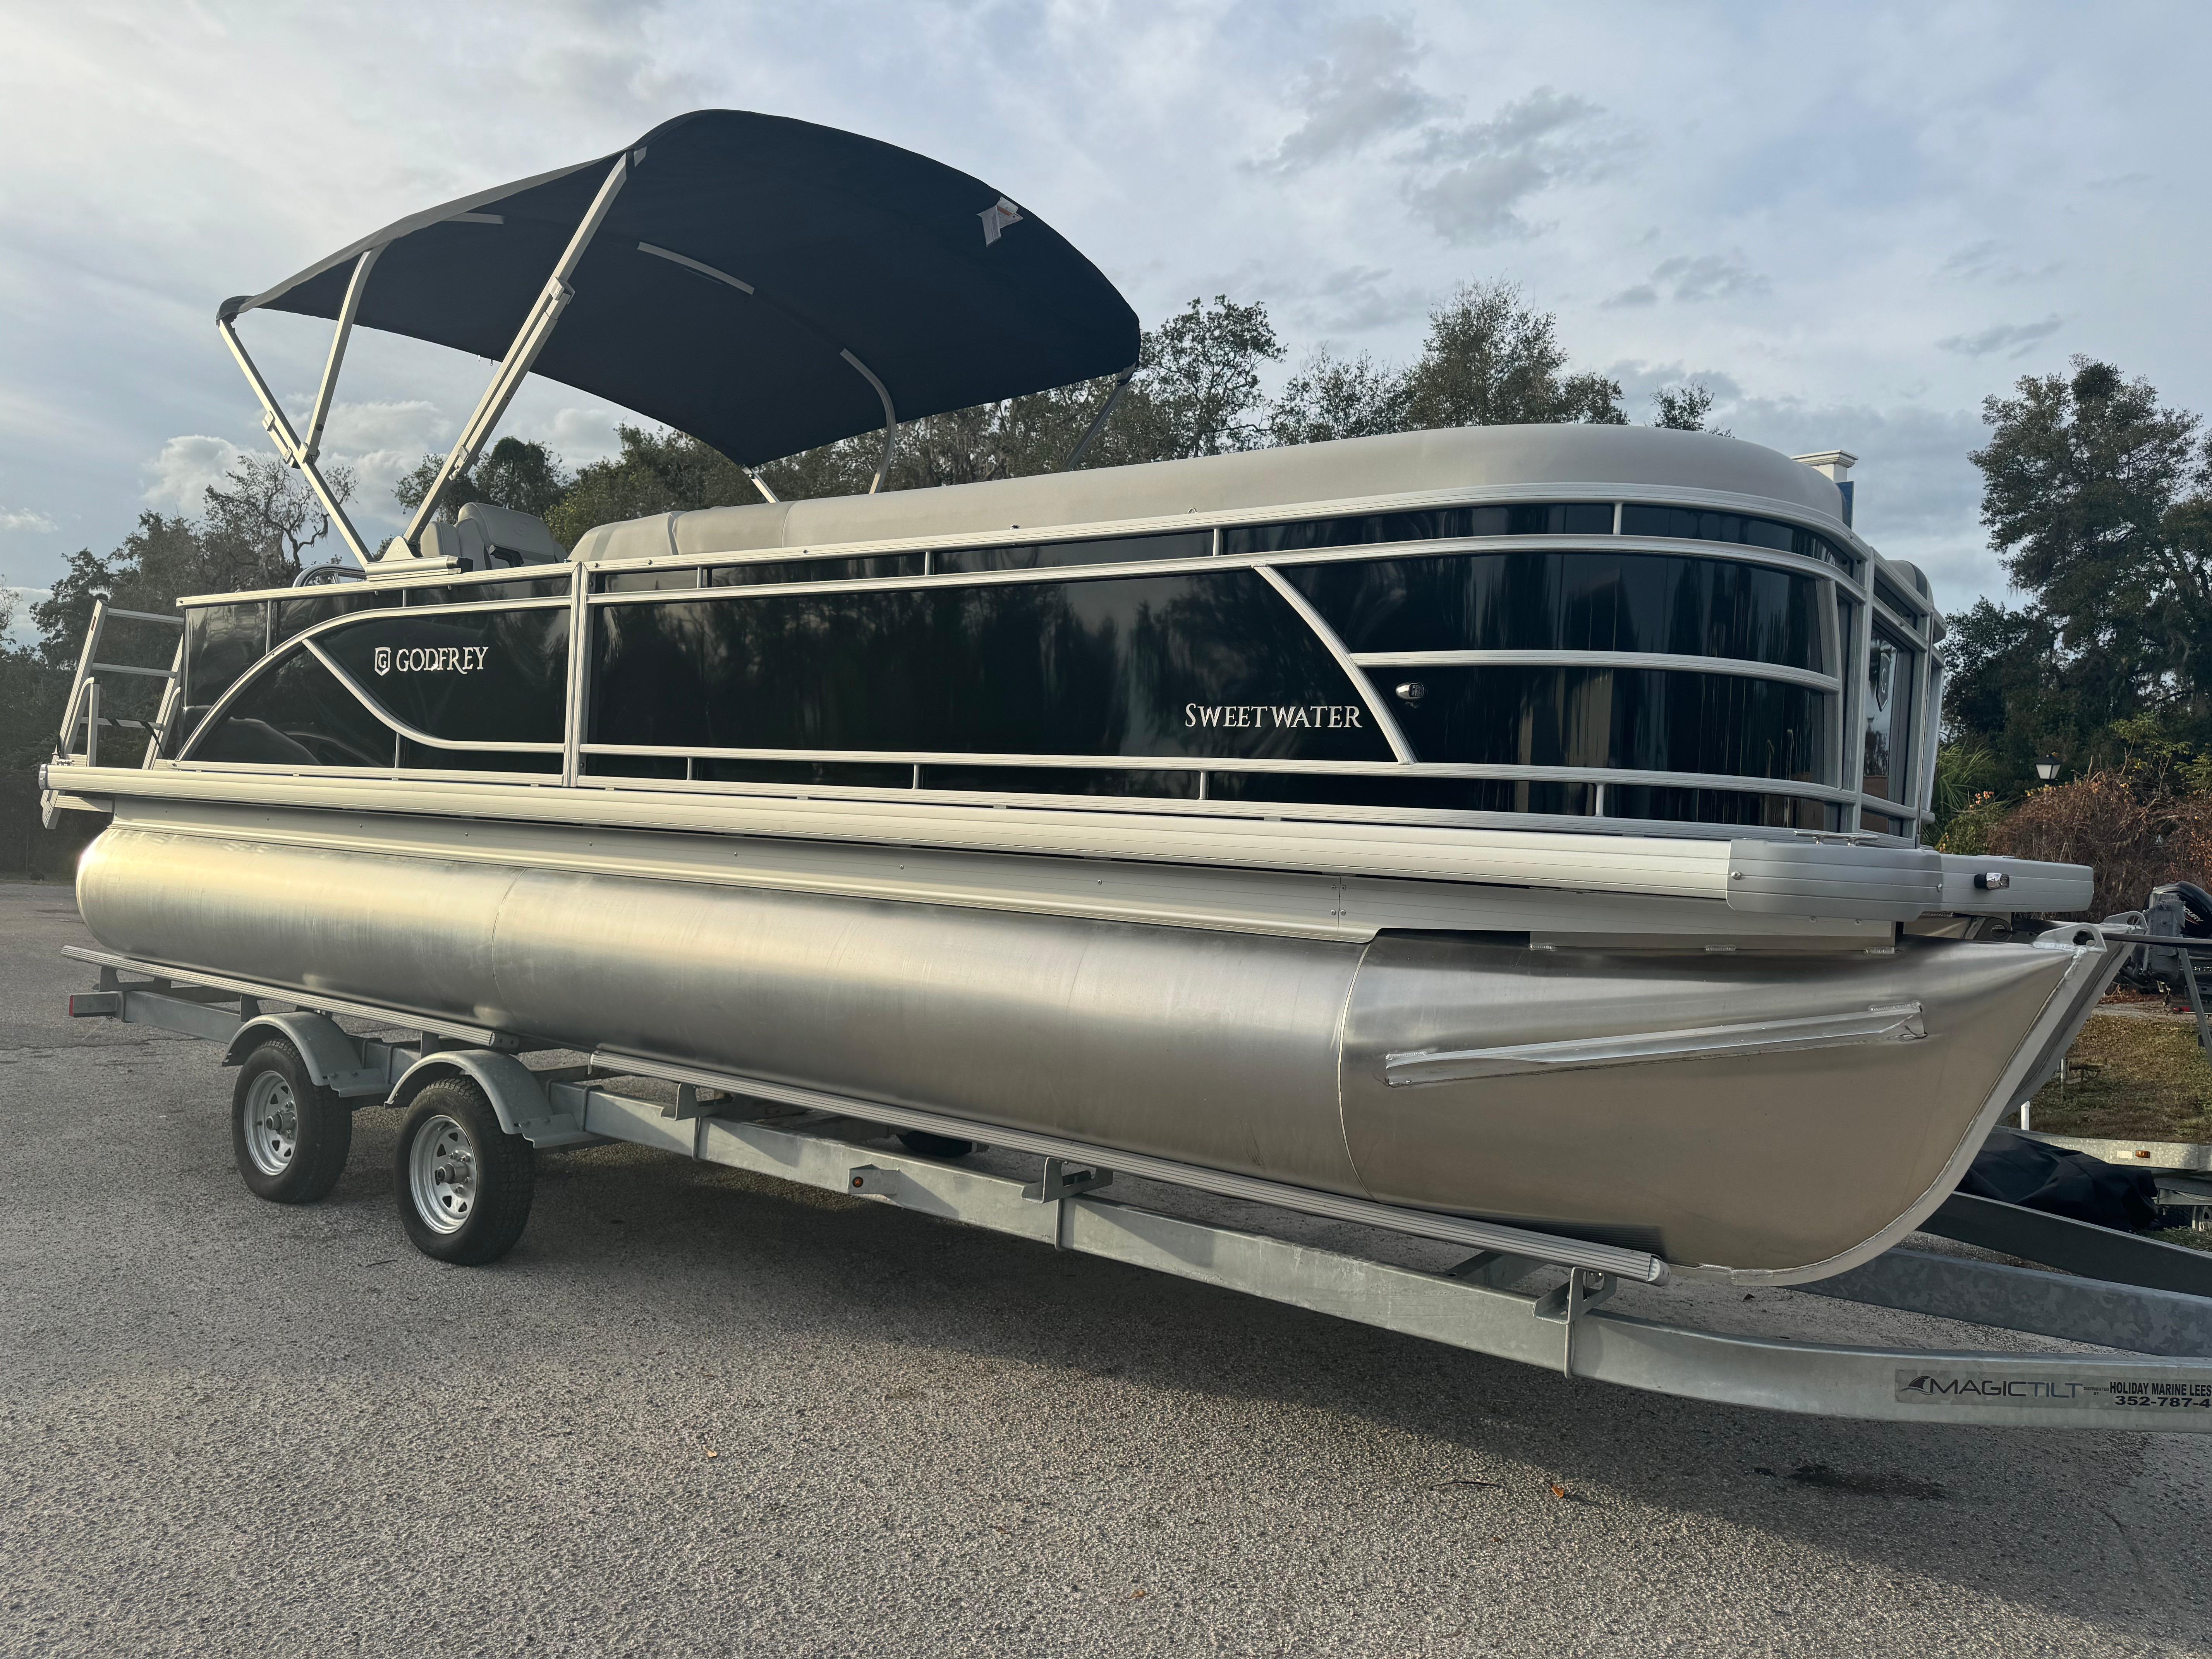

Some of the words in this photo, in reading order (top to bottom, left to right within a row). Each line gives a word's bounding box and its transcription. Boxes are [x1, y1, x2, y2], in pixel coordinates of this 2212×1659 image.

[396, 647, 489, 674] GODFREY
[1185, 703, 1363, 728] SWEETWATER
[1930, 1378, 2083, 1398] MAGICTILT
[2110, 1382, 2149, 1395] HOLIDAY
[2152, 1383, 2186, 1396] MARINE
[2115, 1396, 2212, 1408] 352-787-4
